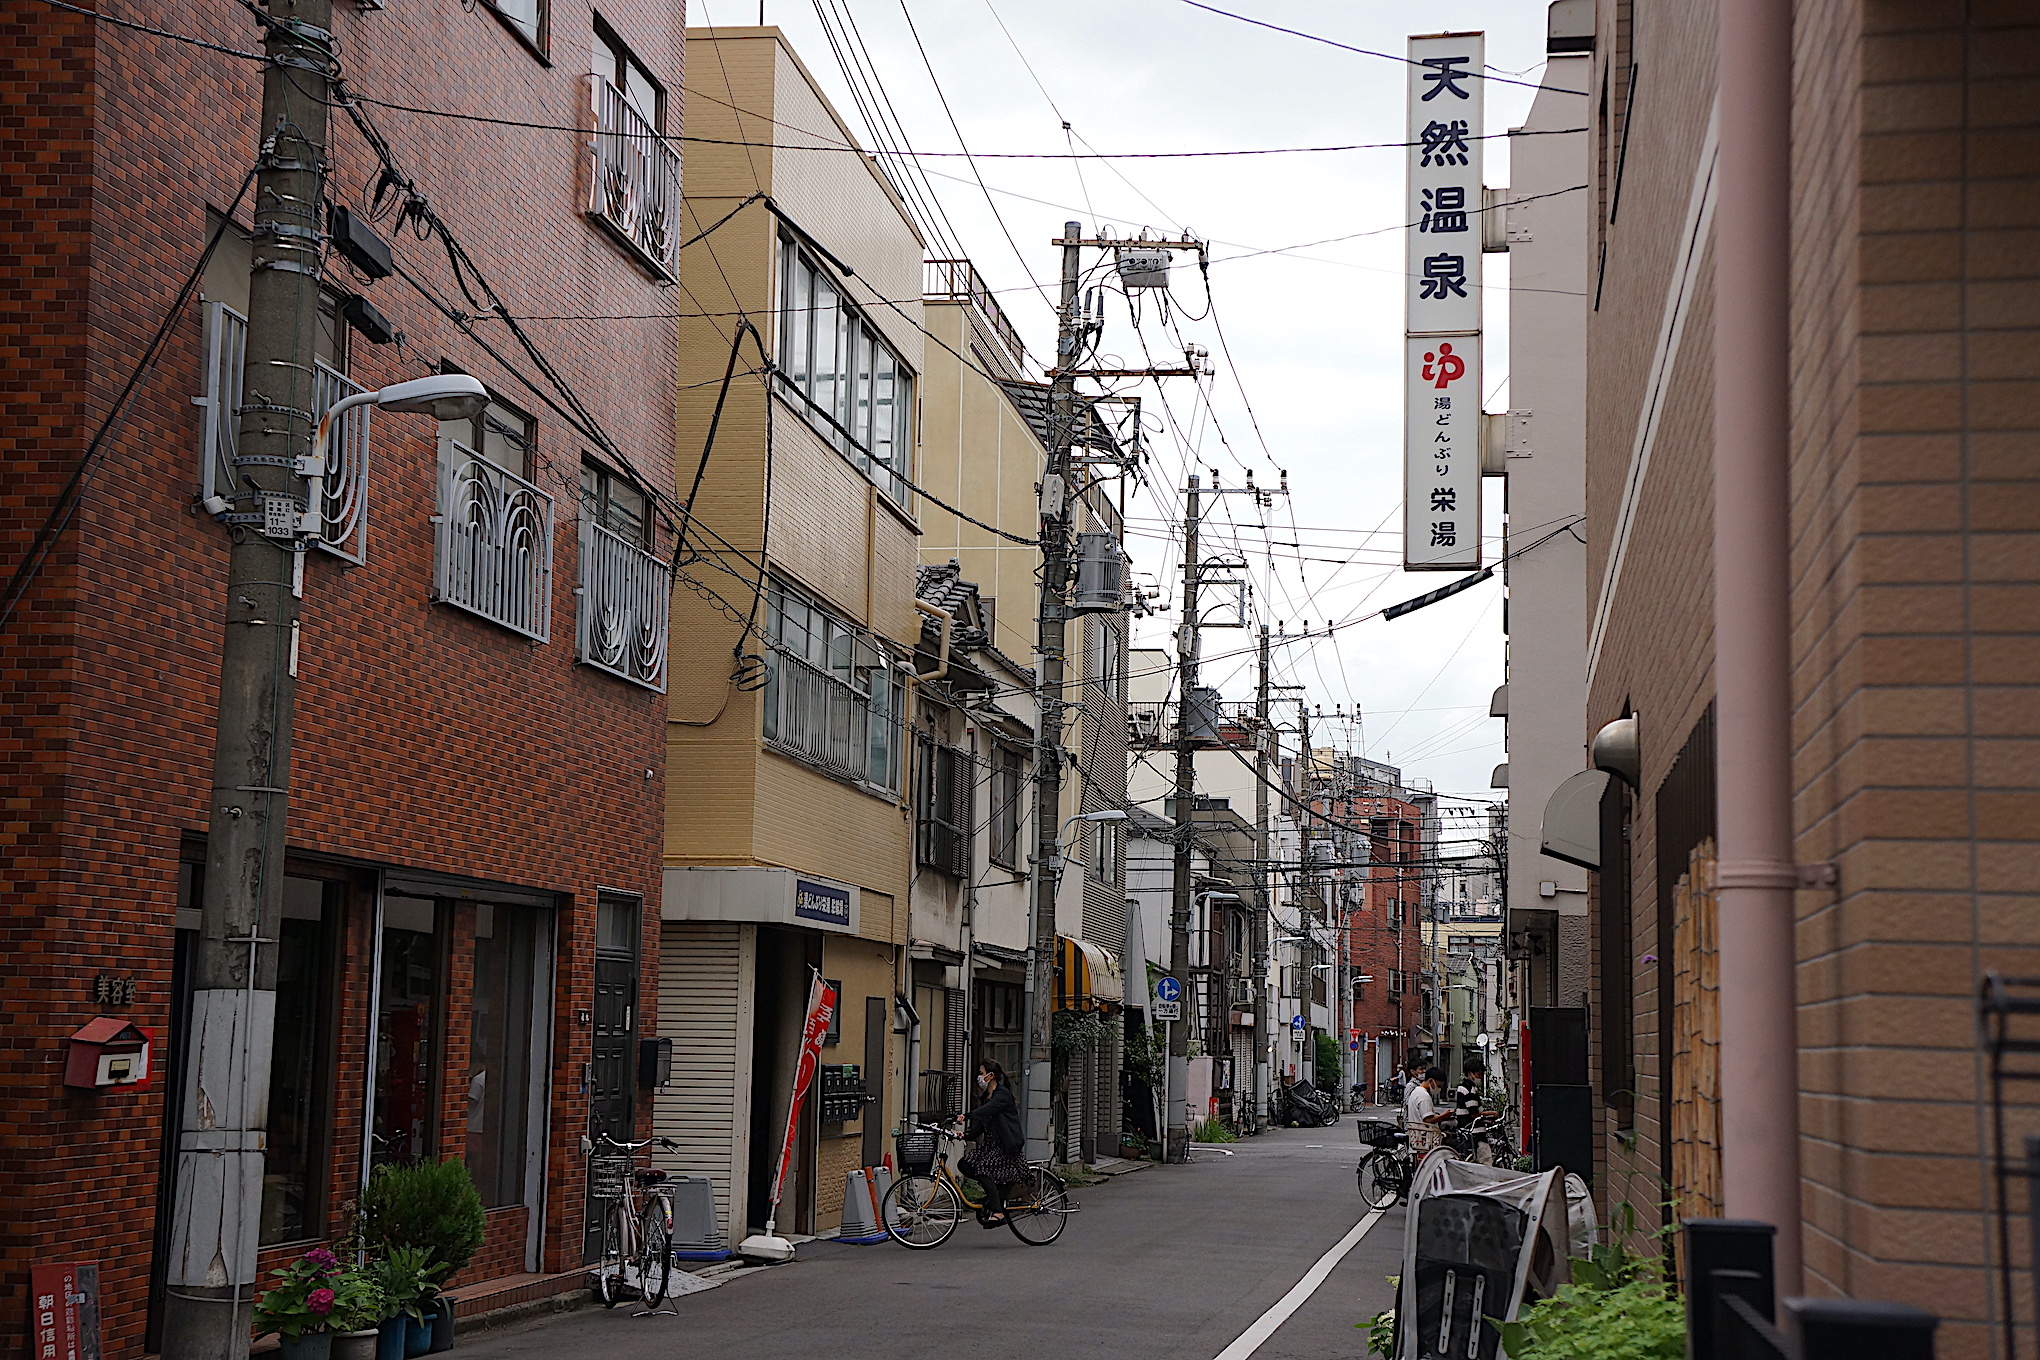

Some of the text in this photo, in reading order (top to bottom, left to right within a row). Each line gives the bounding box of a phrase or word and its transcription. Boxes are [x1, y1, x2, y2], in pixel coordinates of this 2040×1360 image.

[1419, 56, 1470, 300] 天然温泉
[267, 526, 289, 536] 1033
[97, 975, 136, 1005] 美容室
[38, 1294, 56, 1359] 朝日信用
